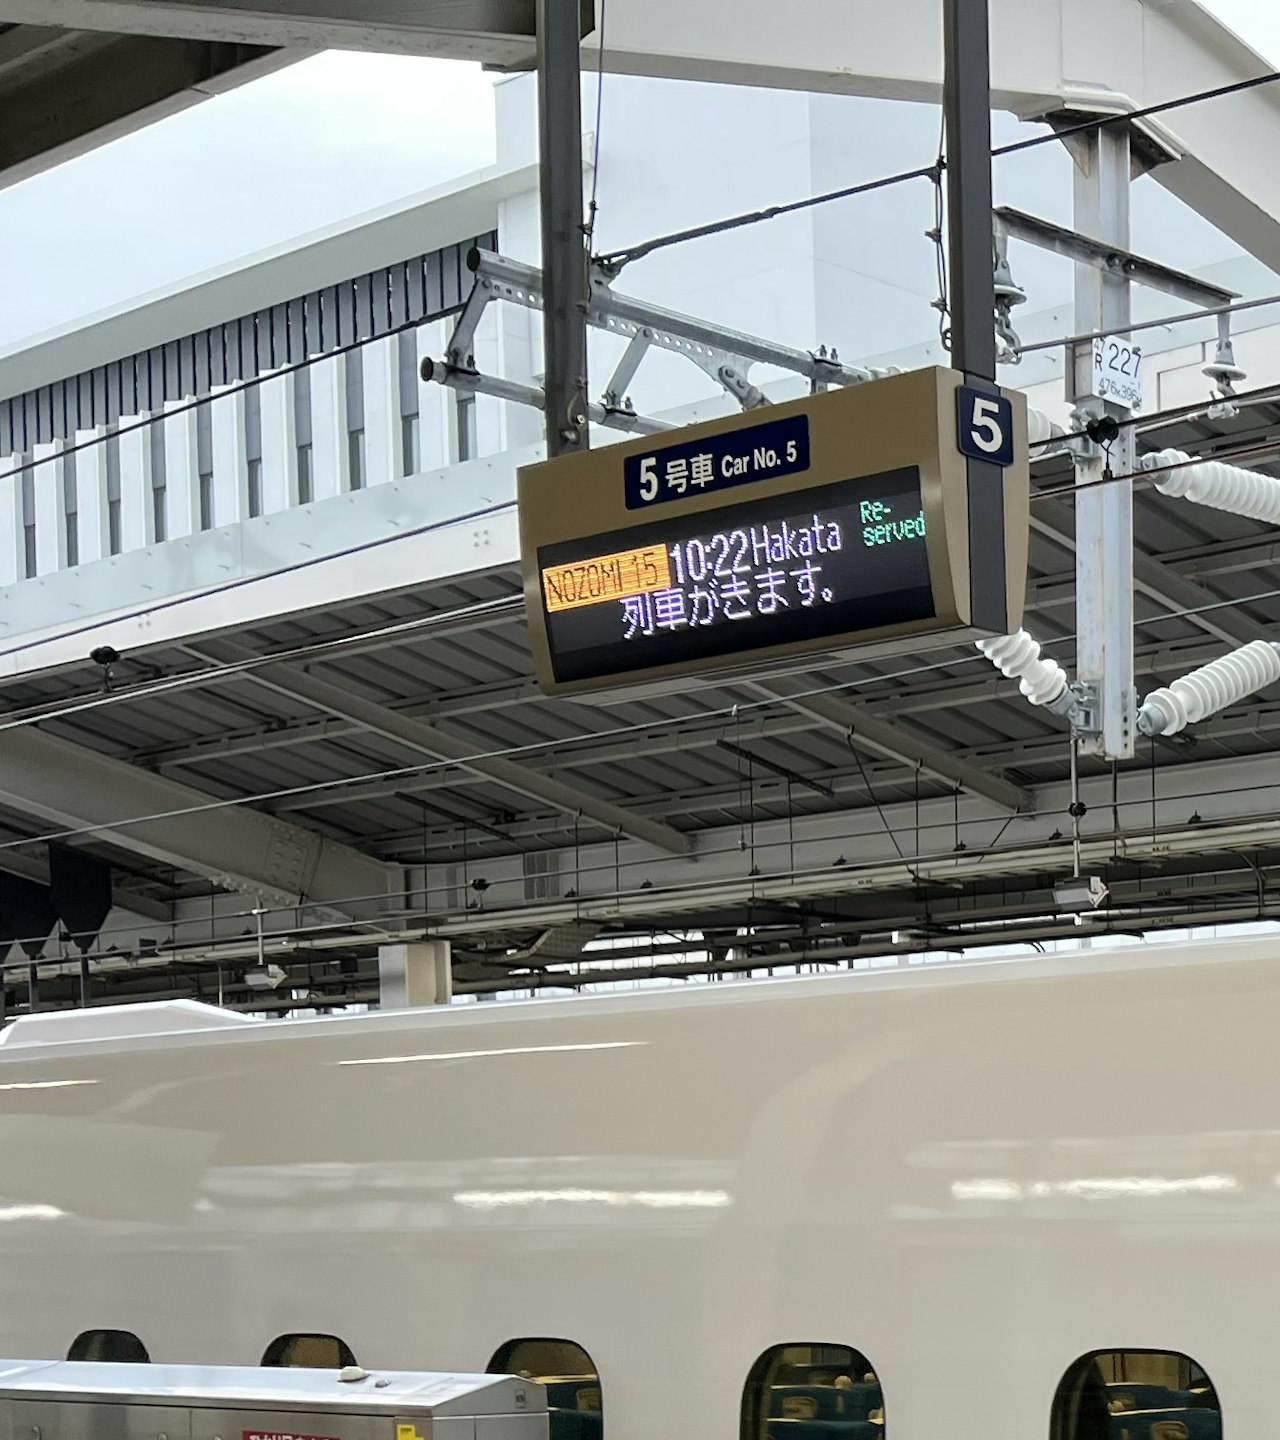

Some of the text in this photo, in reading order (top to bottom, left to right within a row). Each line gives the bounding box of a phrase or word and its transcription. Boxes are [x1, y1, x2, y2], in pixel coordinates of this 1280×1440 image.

[1095, 343, 1141, 378] R 227
[970, 399, 1004, 453] 5
[721, 455, 750, 478] Car
[753, 447, 781, 470] No.
[786, 440, 797, 462] 5
[861, 500, 891, 524] Re-
[863, 511, 926, 546] served
[546, 560, 622, 604] NOZOMI
[669, 530, 750, 584] 10:22
[750, 514, 842, 566] Hakata
[618, 560, 833, 639] 列車がきます。
